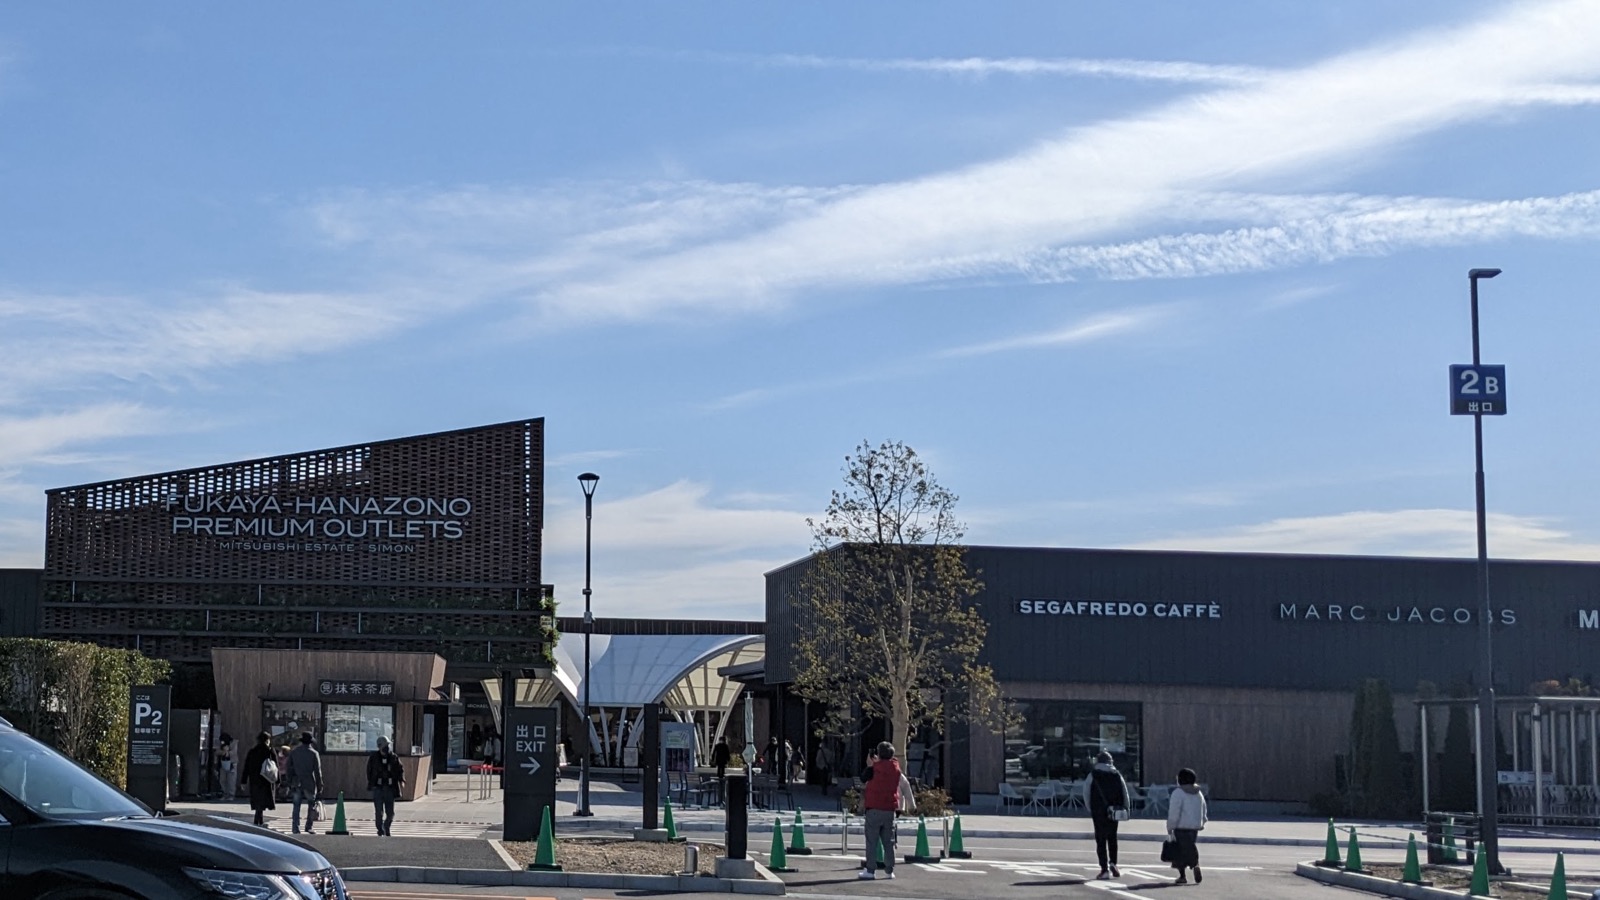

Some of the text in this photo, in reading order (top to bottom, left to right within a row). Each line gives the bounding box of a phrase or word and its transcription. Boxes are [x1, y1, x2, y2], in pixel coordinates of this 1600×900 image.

[1468, 402, 1492, 412] 出口
[165, 495, 472, 517] FUKAYA-HANAZONO
[172, 517, 462, 539] PREMIUM OUTLETS
[219, 542, 414, 553] MITSUBISHI ESTATE SIMON
[1019, 600, 1220, 618] SEGAFREDO CAFFÈ
[1280, 603, 1366, 621] MARC
[516, 725, 546, 738] 出口
[516, 741, 546, 752] EXIT
